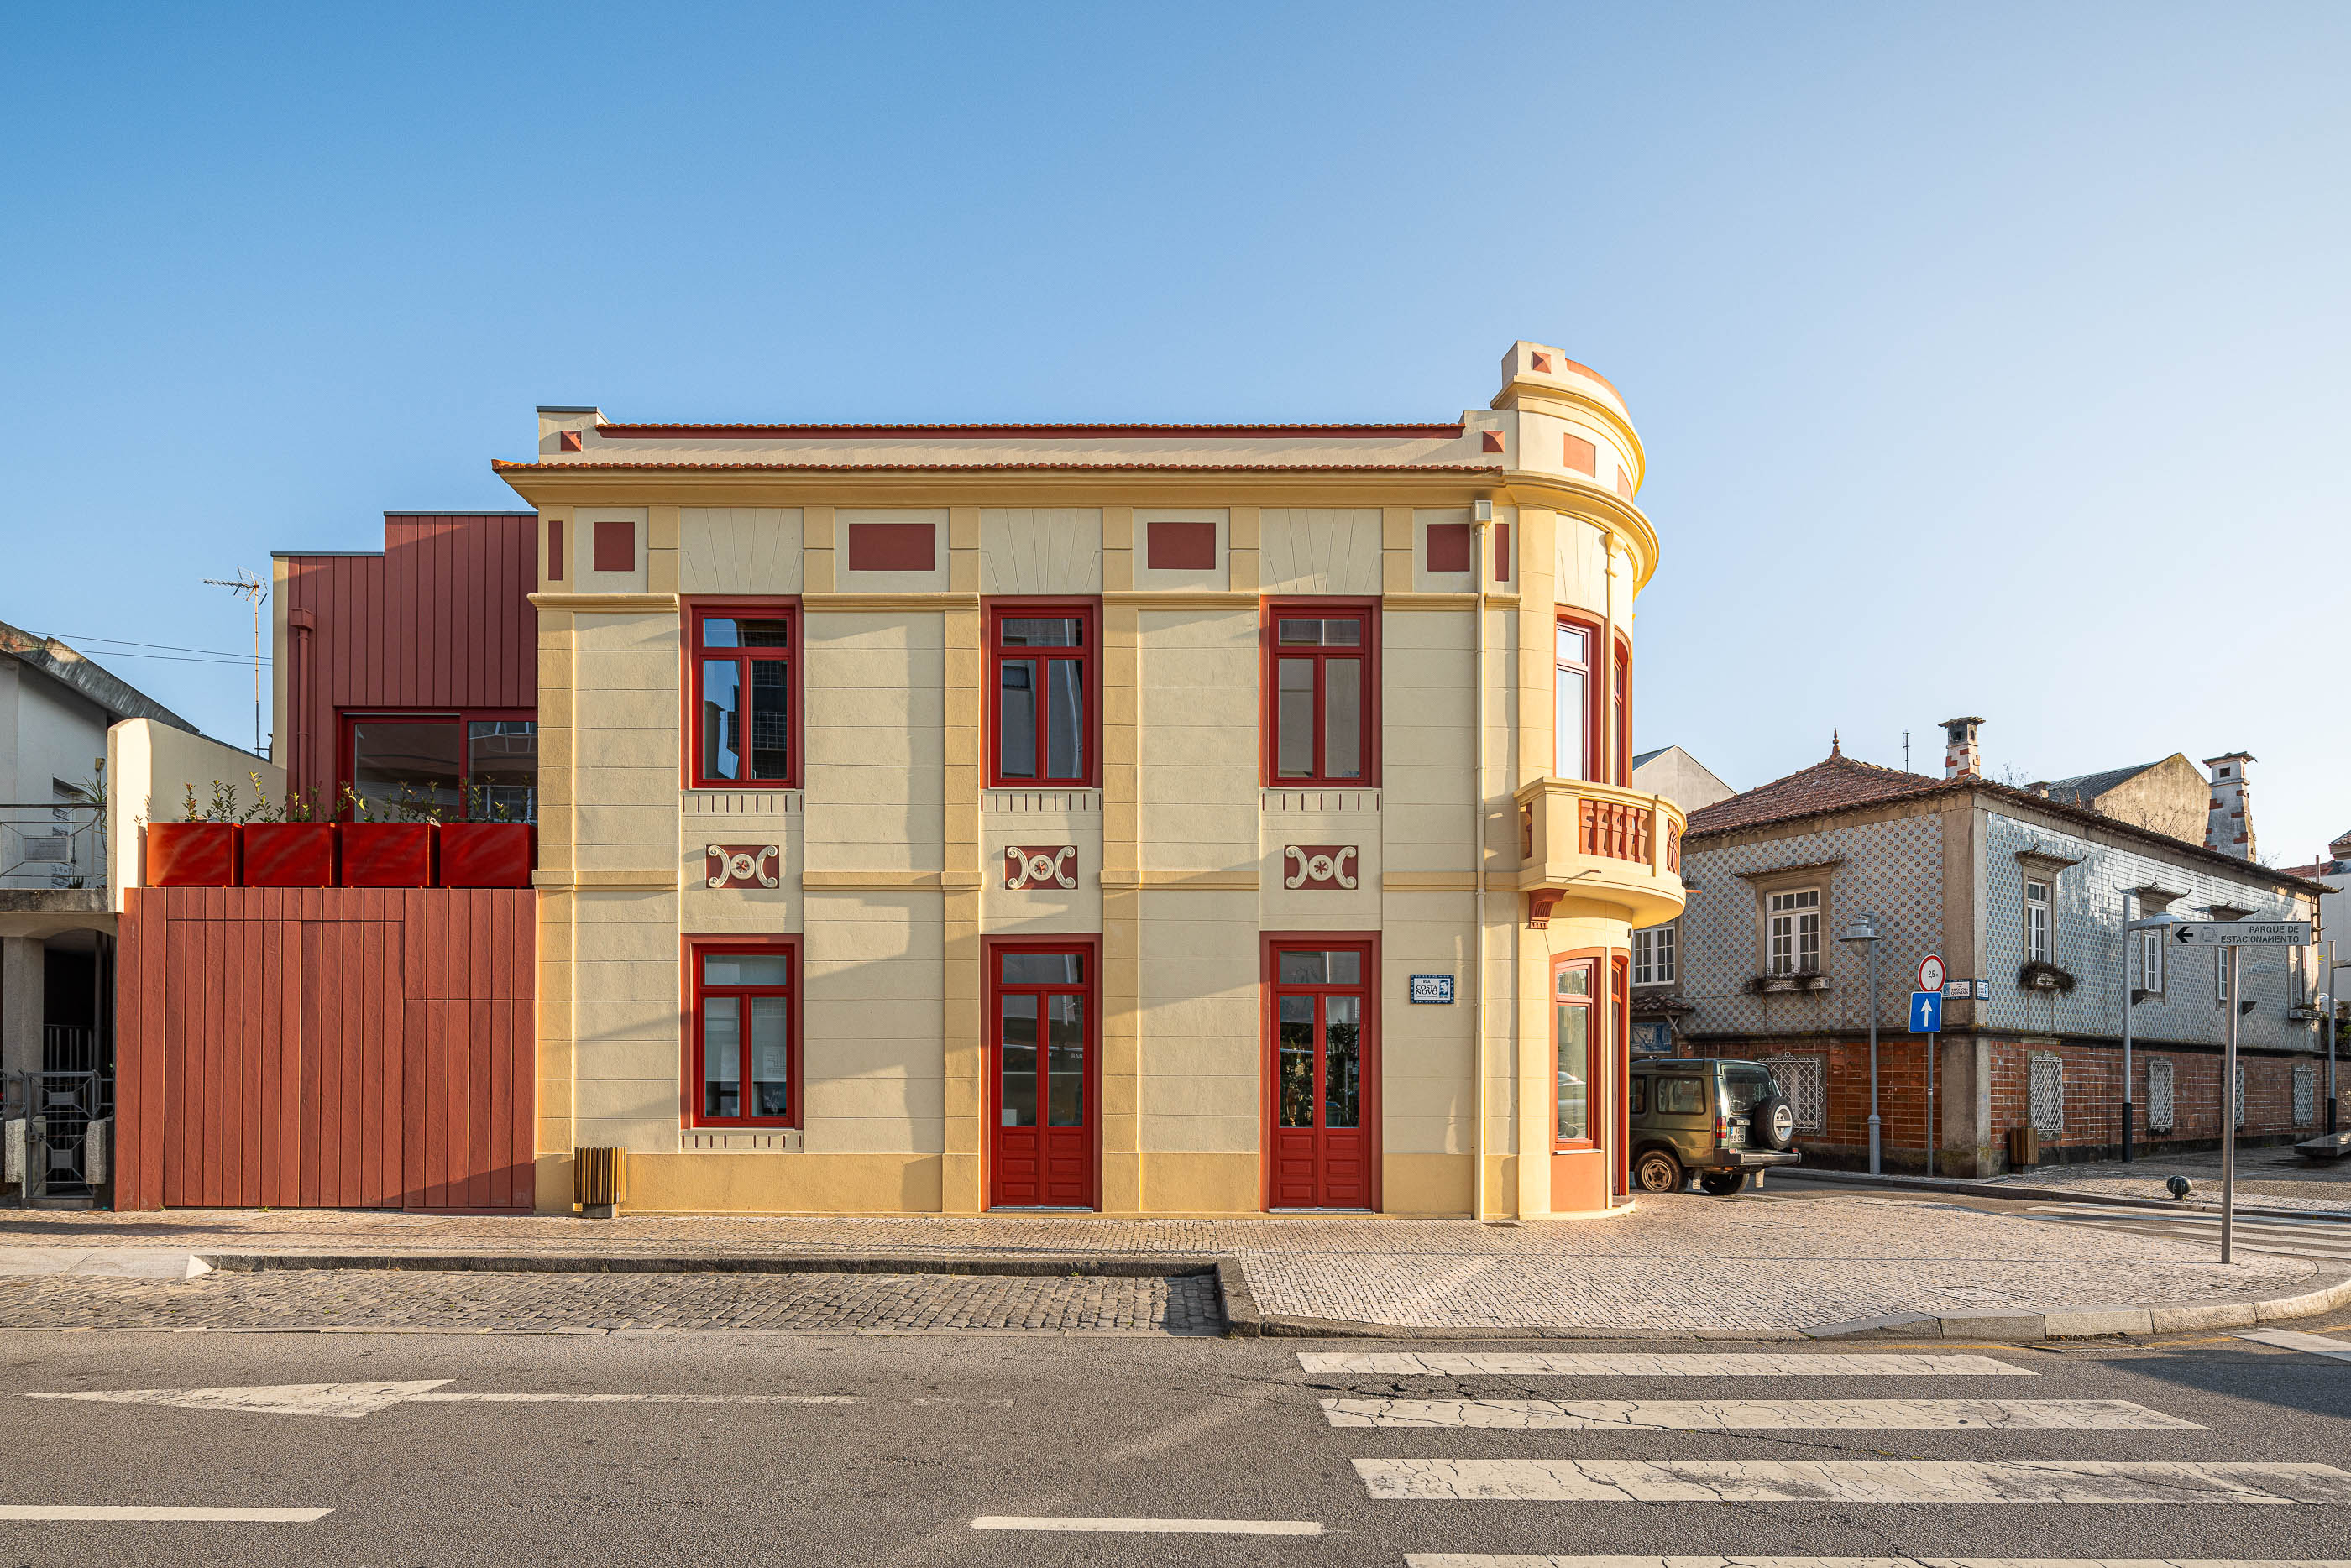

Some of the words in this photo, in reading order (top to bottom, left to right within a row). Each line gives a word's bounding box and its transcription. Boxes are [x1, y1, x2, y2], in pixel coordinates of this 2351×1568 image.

[2249, 925, 2285, 933] PARQUE
[2288, 925, 2299, 933] DE
[2221, 935, 2299, 943] ESTACIONAMENTO
